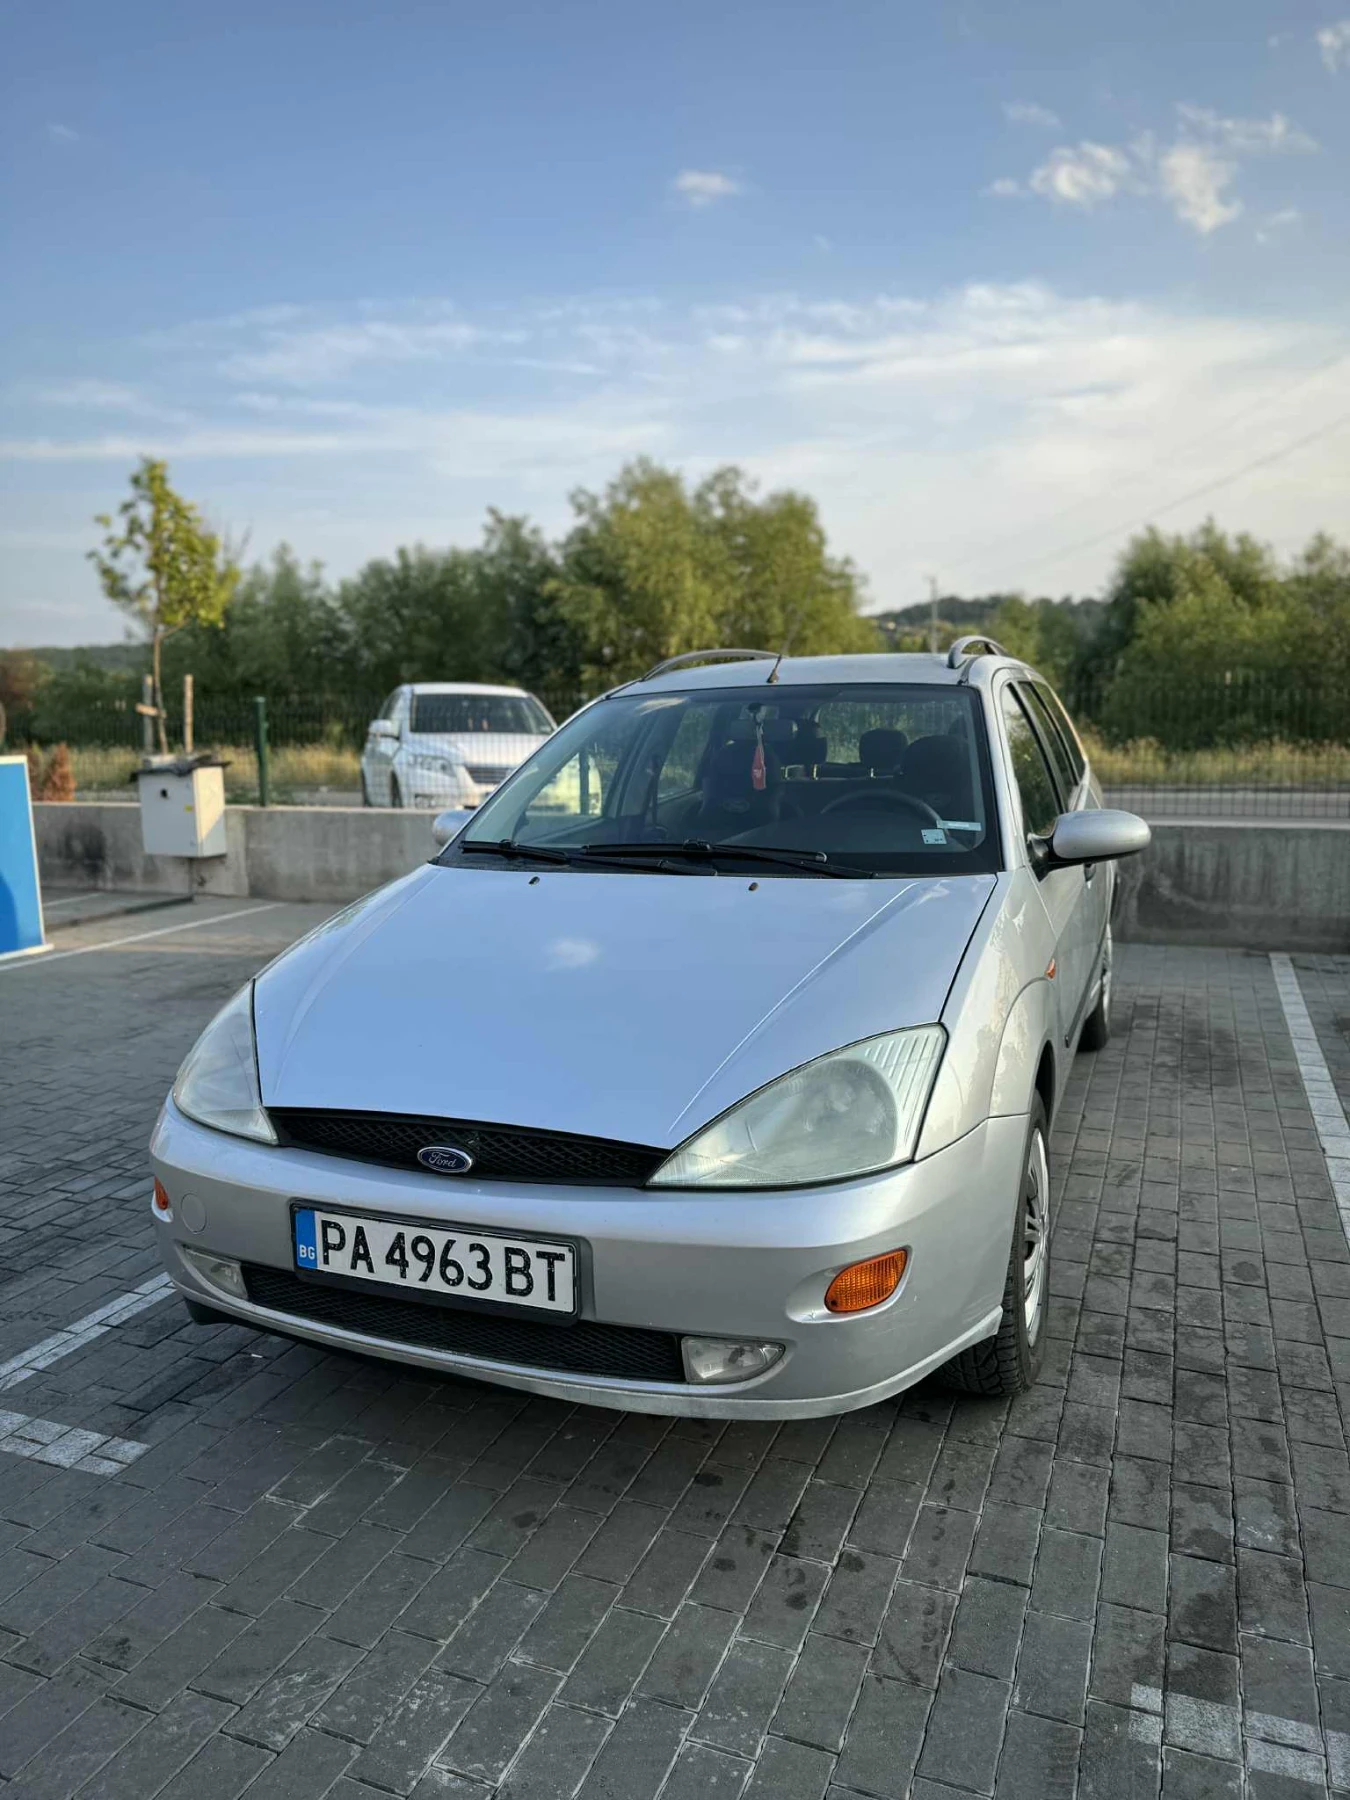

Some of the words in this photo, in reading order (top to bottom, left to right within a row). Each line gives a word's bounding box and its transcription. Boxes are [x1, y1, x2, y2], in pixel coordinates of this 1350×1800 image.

[428, 1151, 457, 1168] Ford
[299, 1244, 315, 1260] BG
[321, 1219, 374, 1273] PA
[385, 1232, 493, 1291] 4963
[504, 1246, 565, 1301] BT
